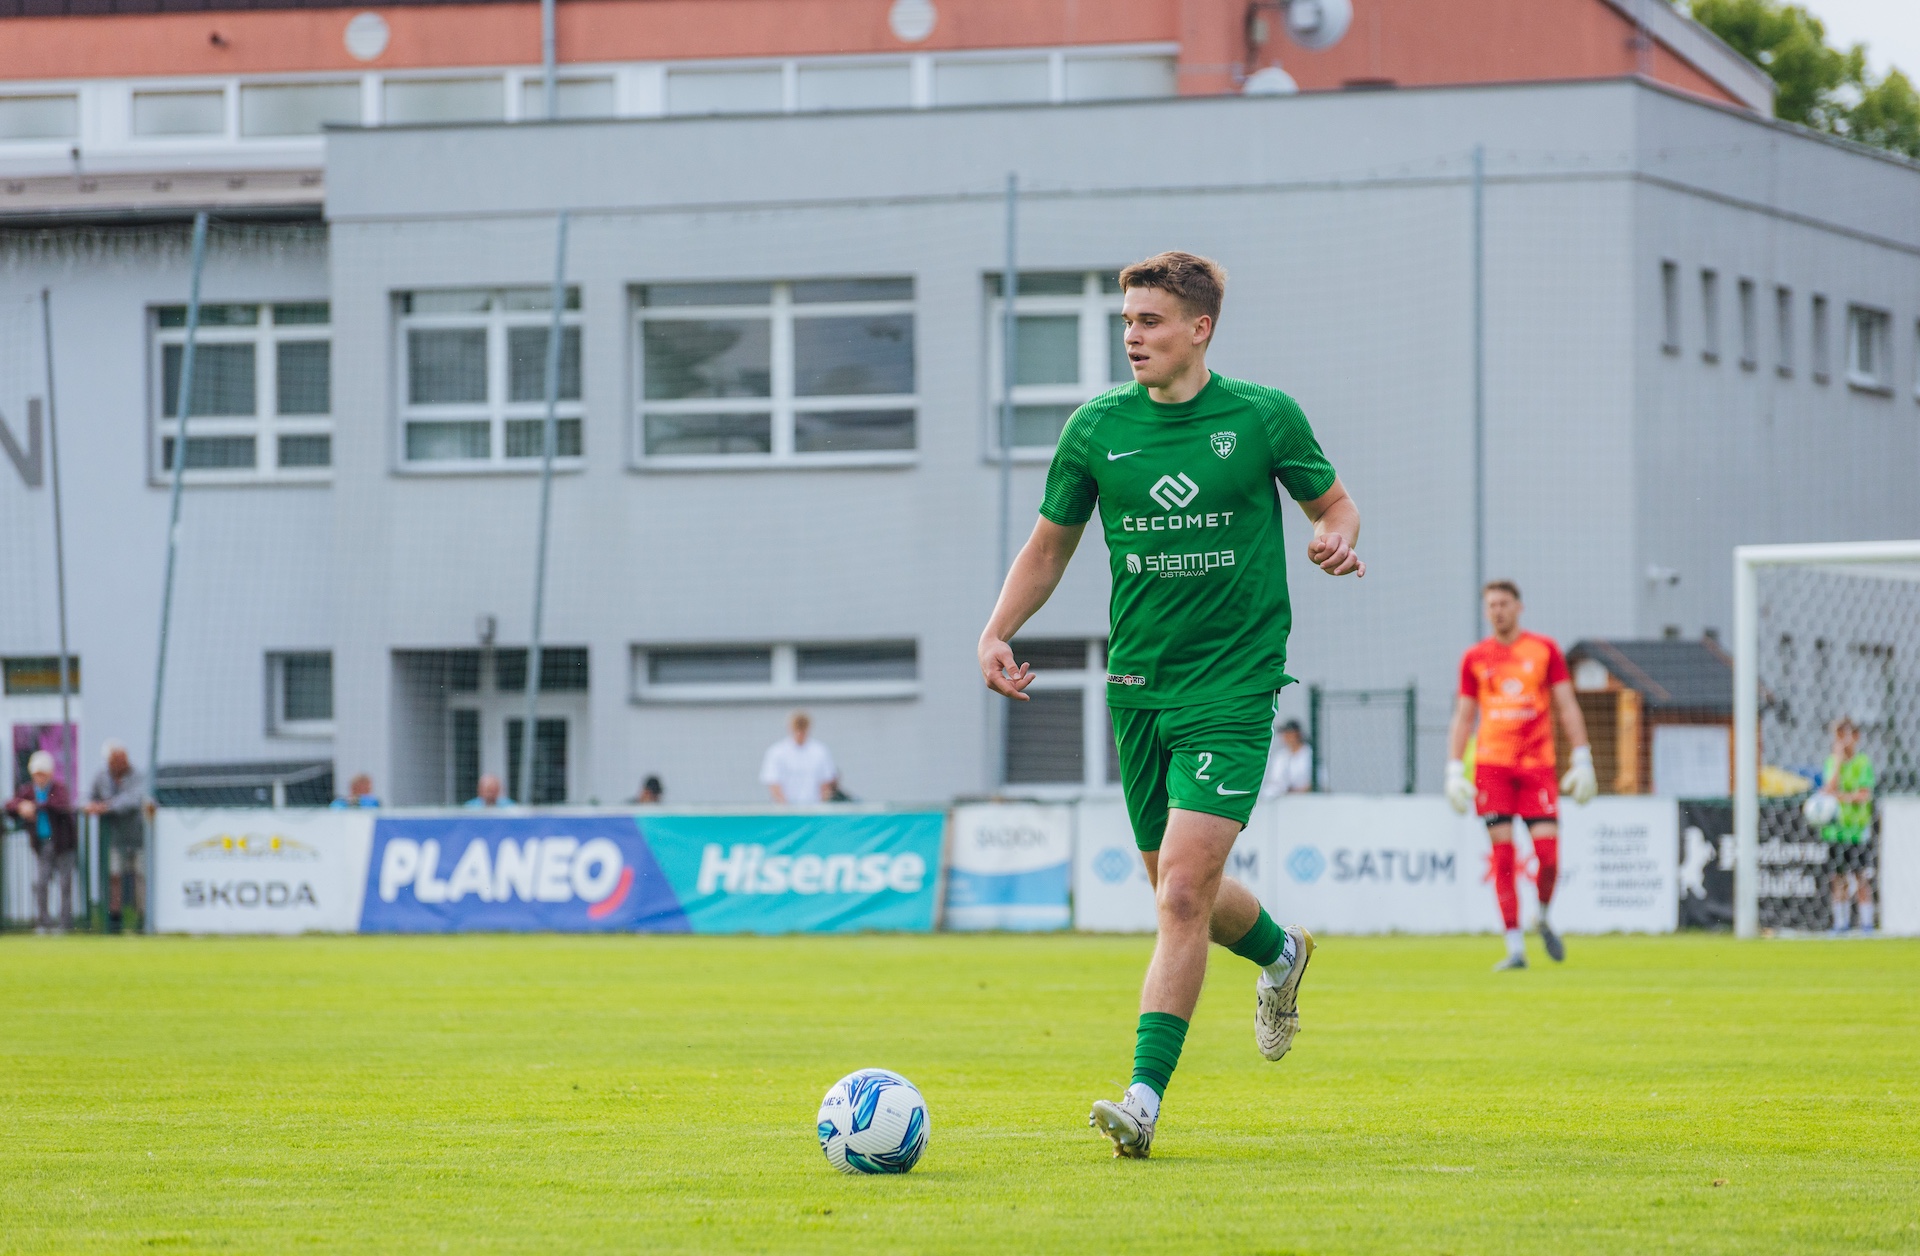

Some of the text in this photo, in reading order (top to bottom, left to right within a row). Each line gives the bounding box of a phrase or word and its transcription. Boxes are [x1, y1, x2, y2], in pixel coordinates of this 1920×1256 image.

[1122, 511, 1233, 531] ČECOMET
[1146, 550, 1236, 572] stampa
[1159, 569, 1206, 578] OSTRAVA
[1195, 752, 1213, 780] 2
[379, 836, 624, 903] PLANEO
[696, 843, 926, 895] Hisense
[1331, 848, 1458, 883] SATUM
